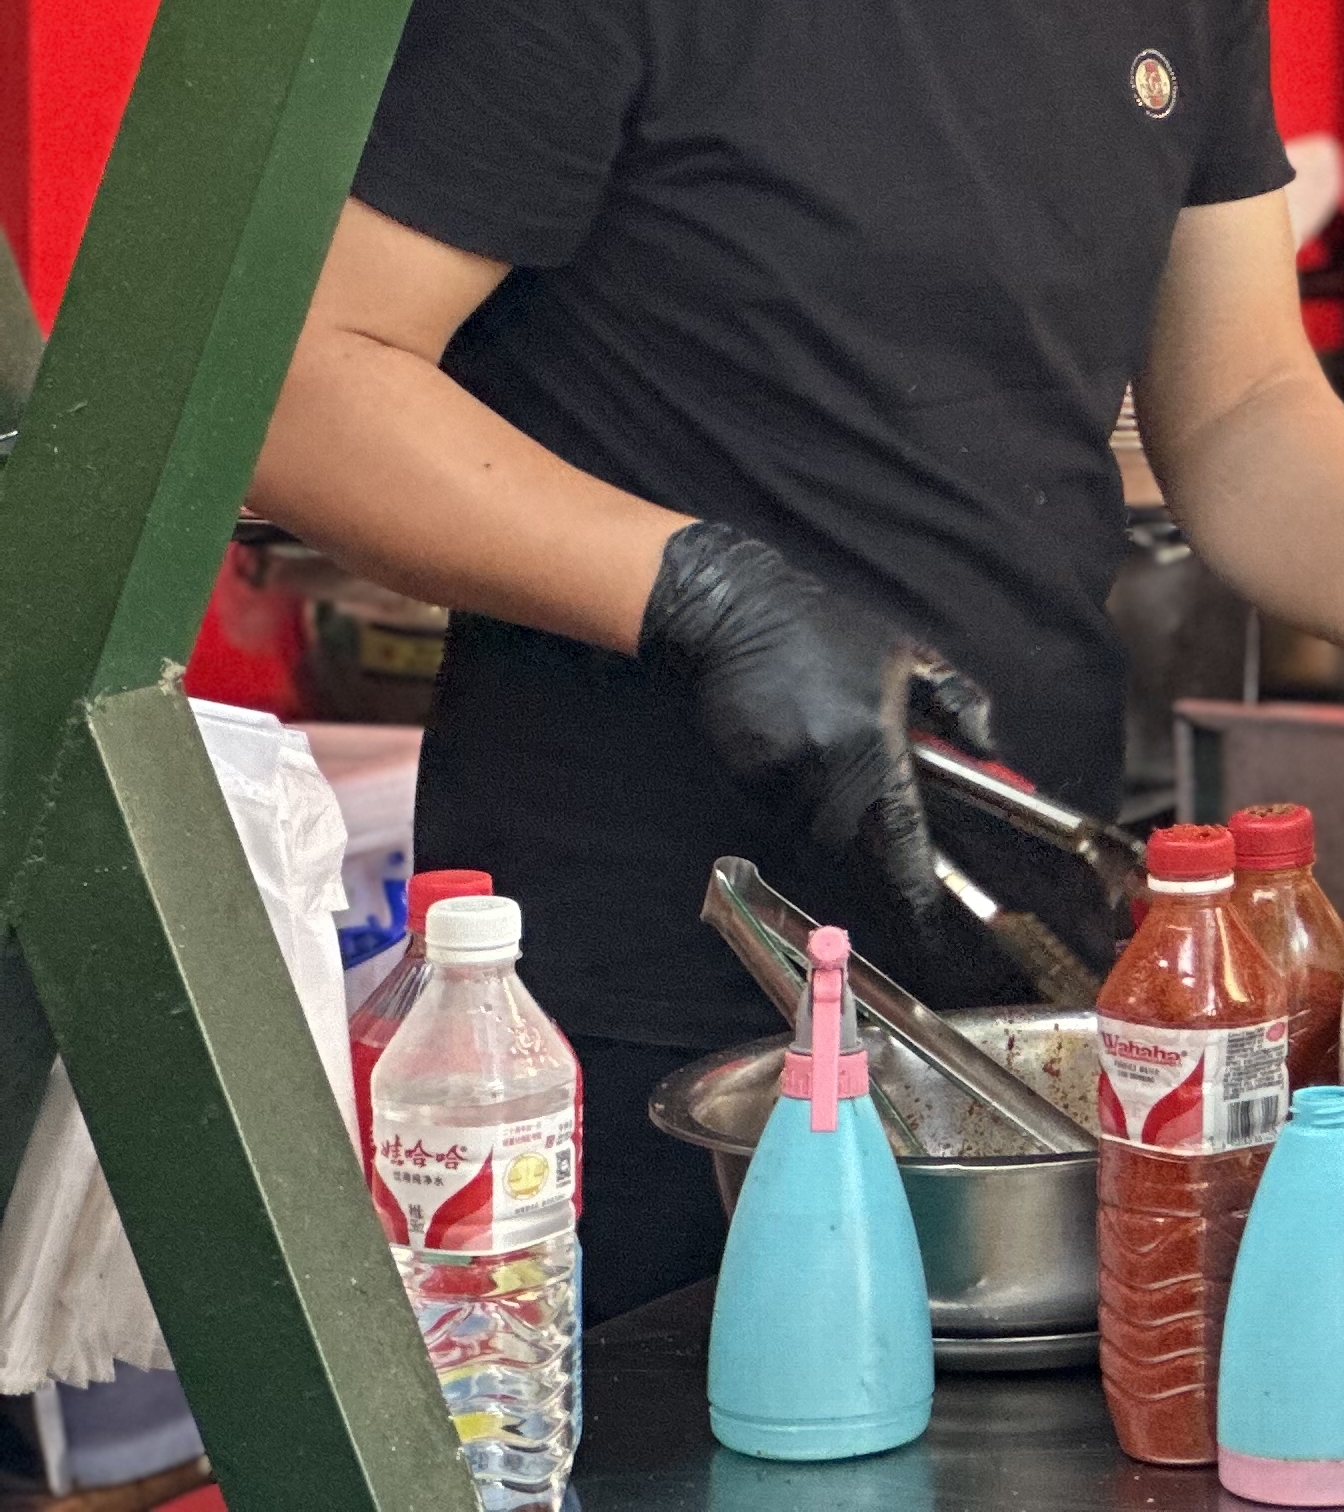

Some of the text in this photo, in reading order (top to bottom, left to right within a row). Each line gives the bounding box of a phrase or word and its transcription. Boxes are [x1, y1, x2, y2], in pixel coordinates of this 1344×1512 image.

[1101, 1031, 1183, 1067] Wahaha
[381, 1134, 469, 1170] 娃哈哈
